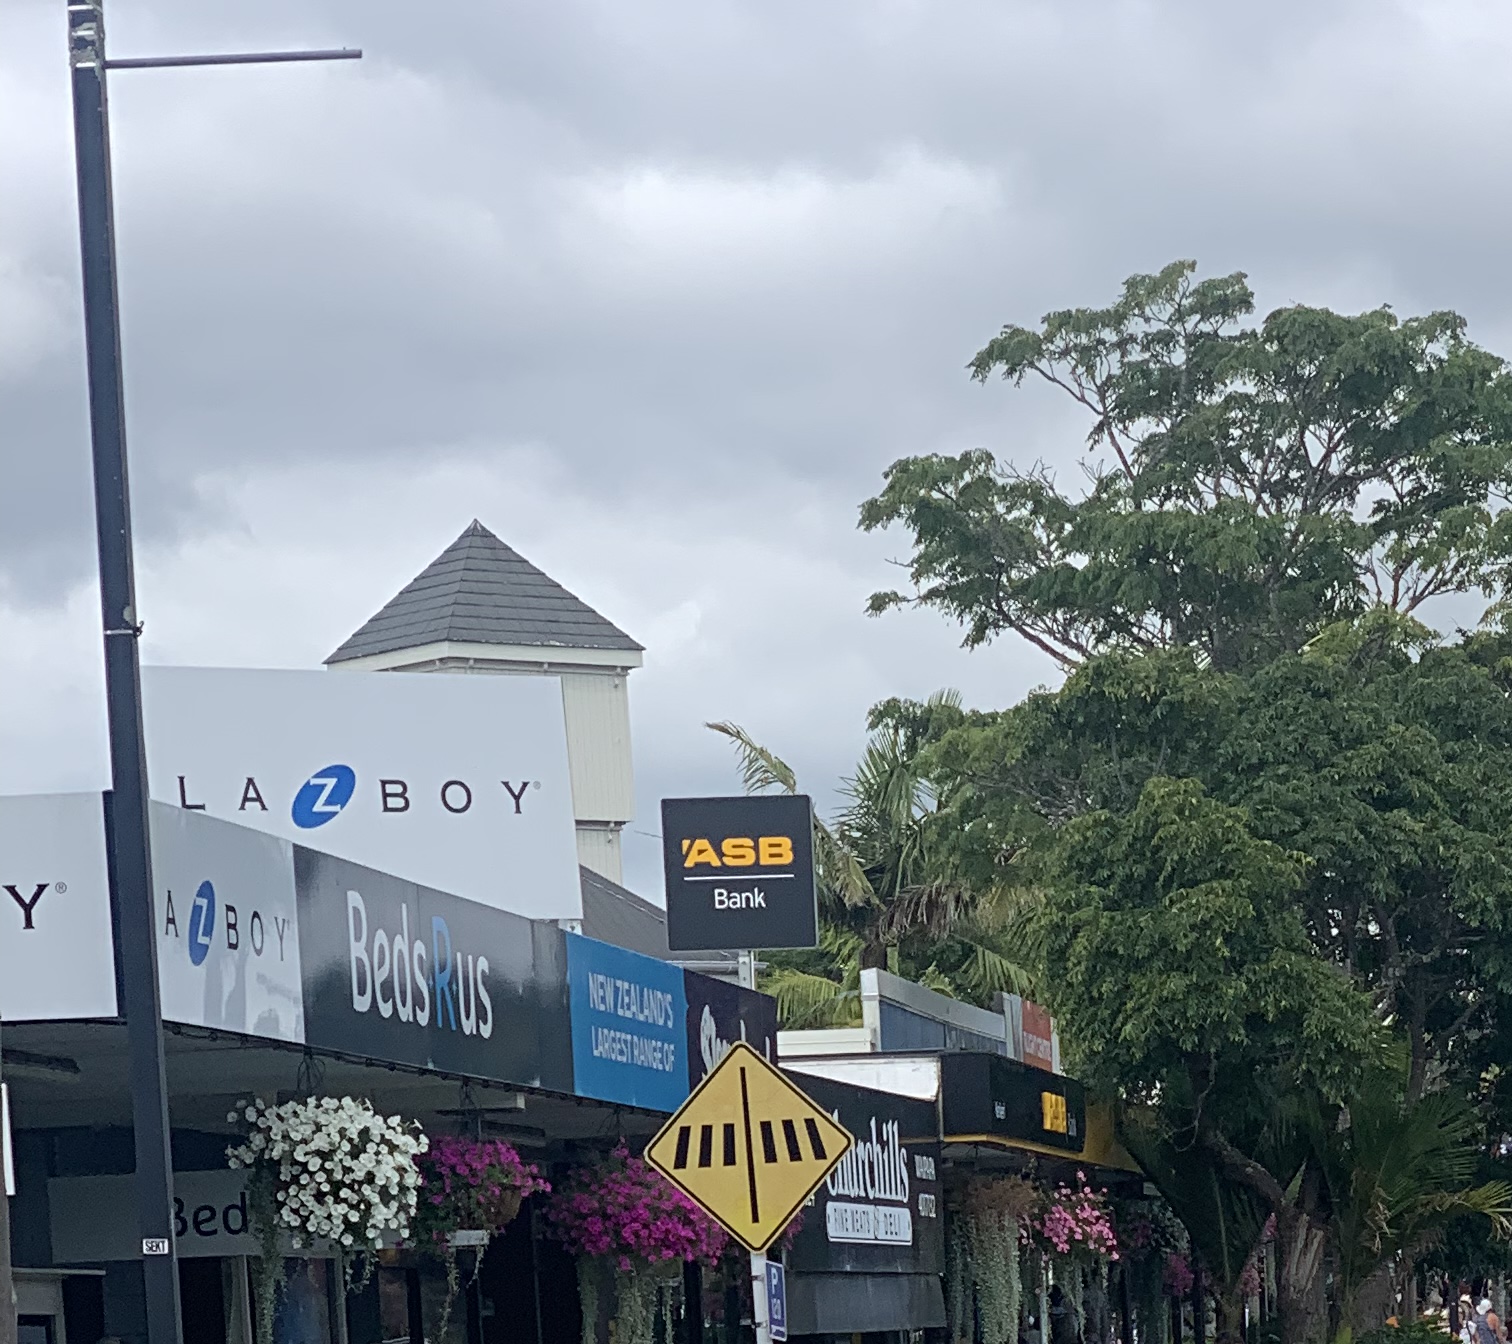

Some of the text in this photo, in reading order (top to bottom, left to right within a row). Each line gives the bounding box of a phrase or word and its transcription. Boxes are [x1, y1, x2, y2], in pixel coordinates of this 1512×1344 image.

[682, 836, 794, 867] ASB
[714, 886, 766, 909] Bank
[588, 971, 673, 1029] NEW ZEALAND'S
[591, 1025, 631, 1063] LARGEST
[632, 1036, 662, 1071] RANGE
[663, 1042, 675, 1073] OF
[770, 1267, 779, 1294] P
